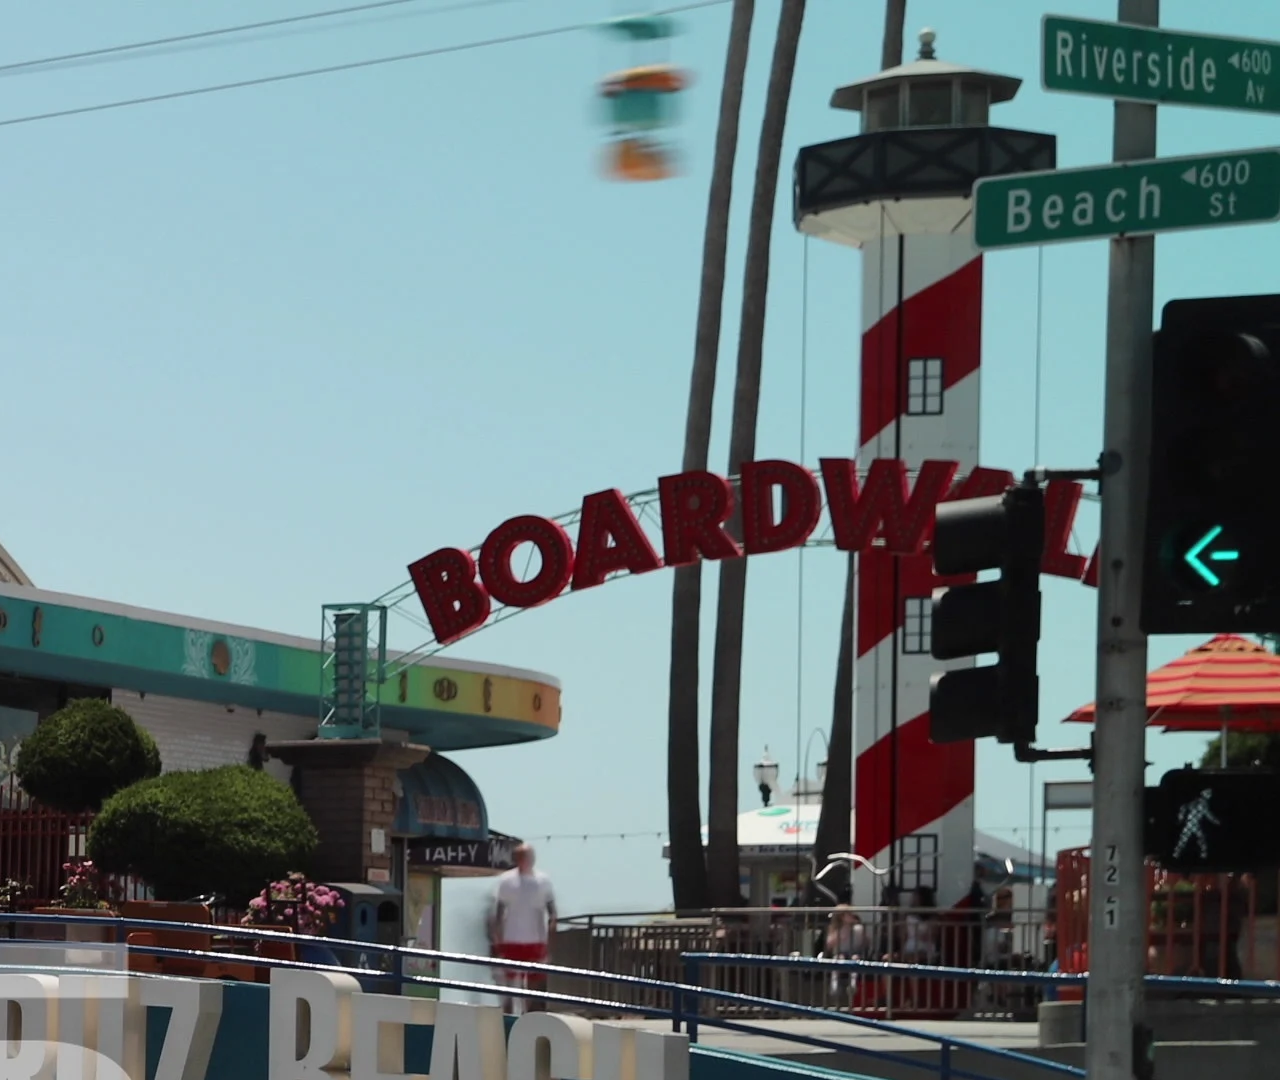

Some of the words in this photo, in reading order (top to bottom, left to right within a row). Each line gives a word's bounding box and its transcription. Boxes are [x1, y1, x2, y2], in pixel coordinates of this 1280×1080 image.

[1055, 30, 1217, 93] Riverside
[1241, 49, 1272, 75] 600
[1245, 80, 1265, 103] Av
[1006, 175, 1161, 234] Beach
[1199, 160, 1250, 188] 600
[1209, 191, 1238, 217] St
[407, 457, 1097, 644] BOARDWL
